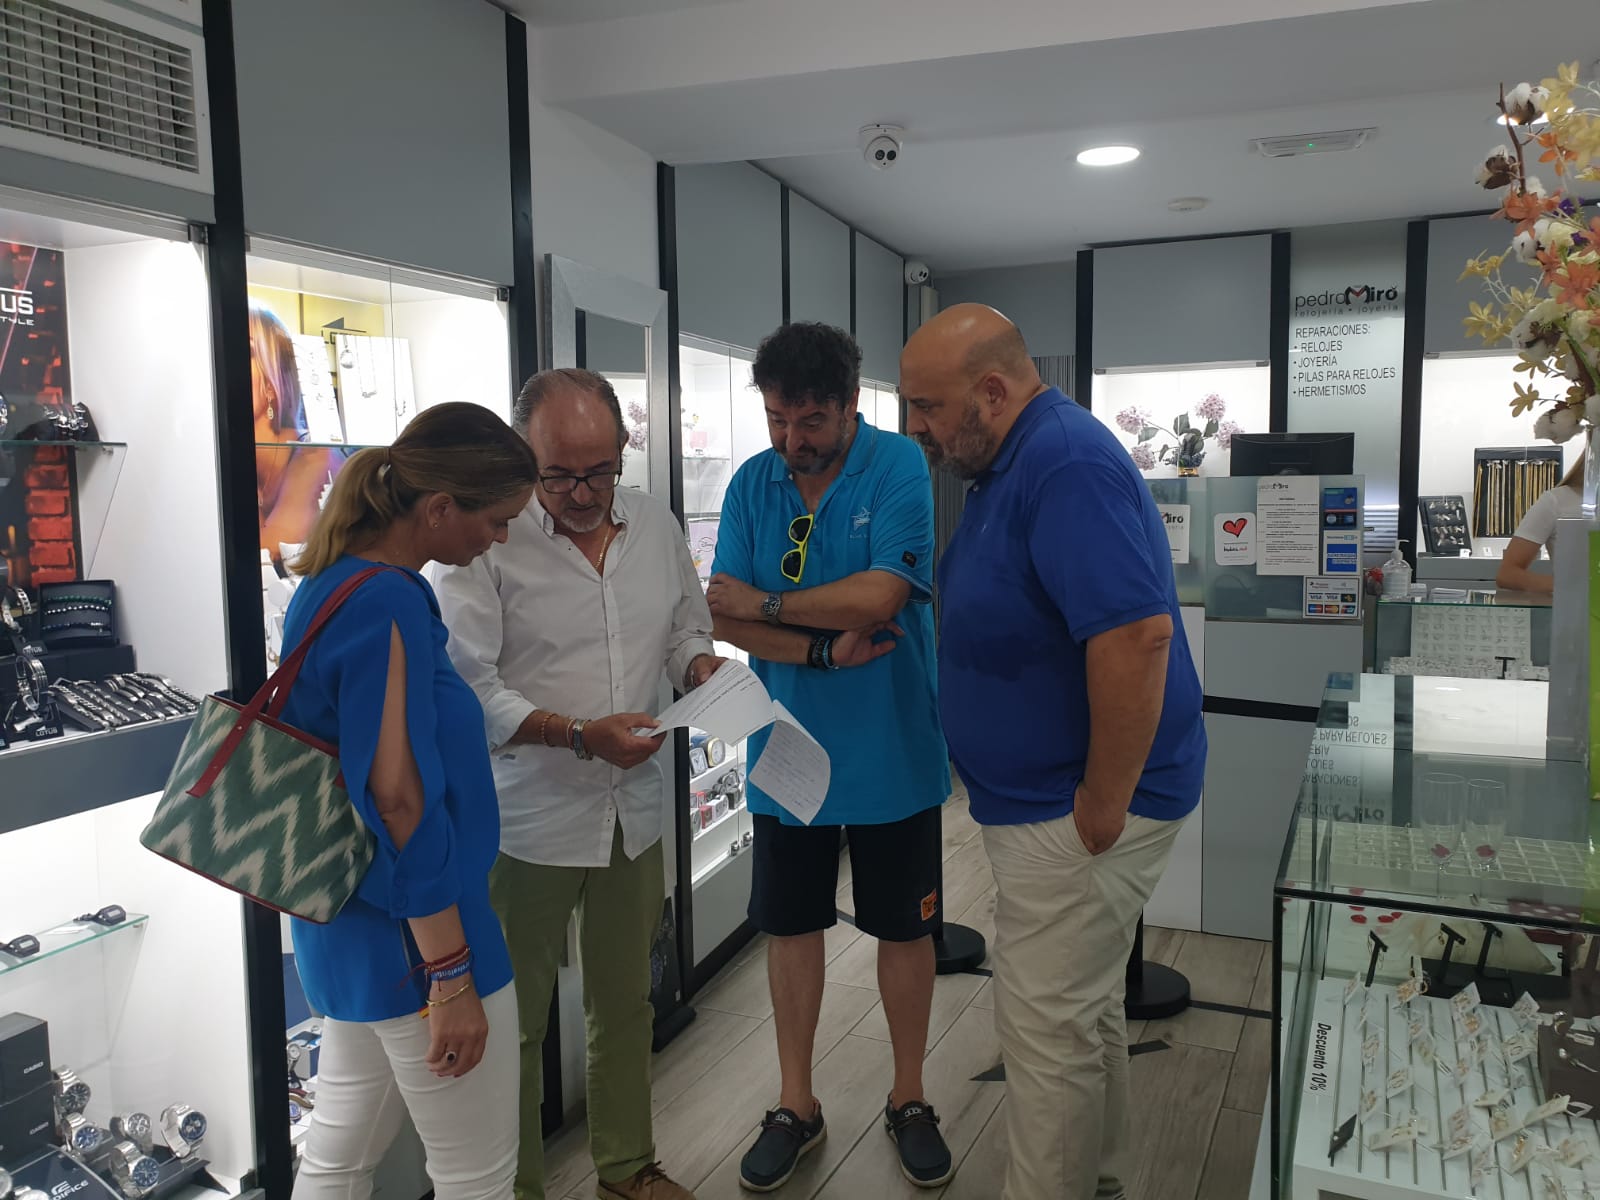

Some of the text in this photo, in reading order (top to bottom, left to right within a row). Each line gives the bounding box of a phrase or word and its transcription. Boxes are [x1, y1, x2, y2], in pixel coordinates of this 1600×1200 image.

[1300, 340, 1343, 353] RELOJES
[1298, 354, 1338, 368] JOYERÍA
[1298, 367, 1396, 382] PILAS PARA RELOJES
[1298, 384, 1367, 397] HERMETISMOS
[1310, 1022, 1332, 1091] Descuento 10%
